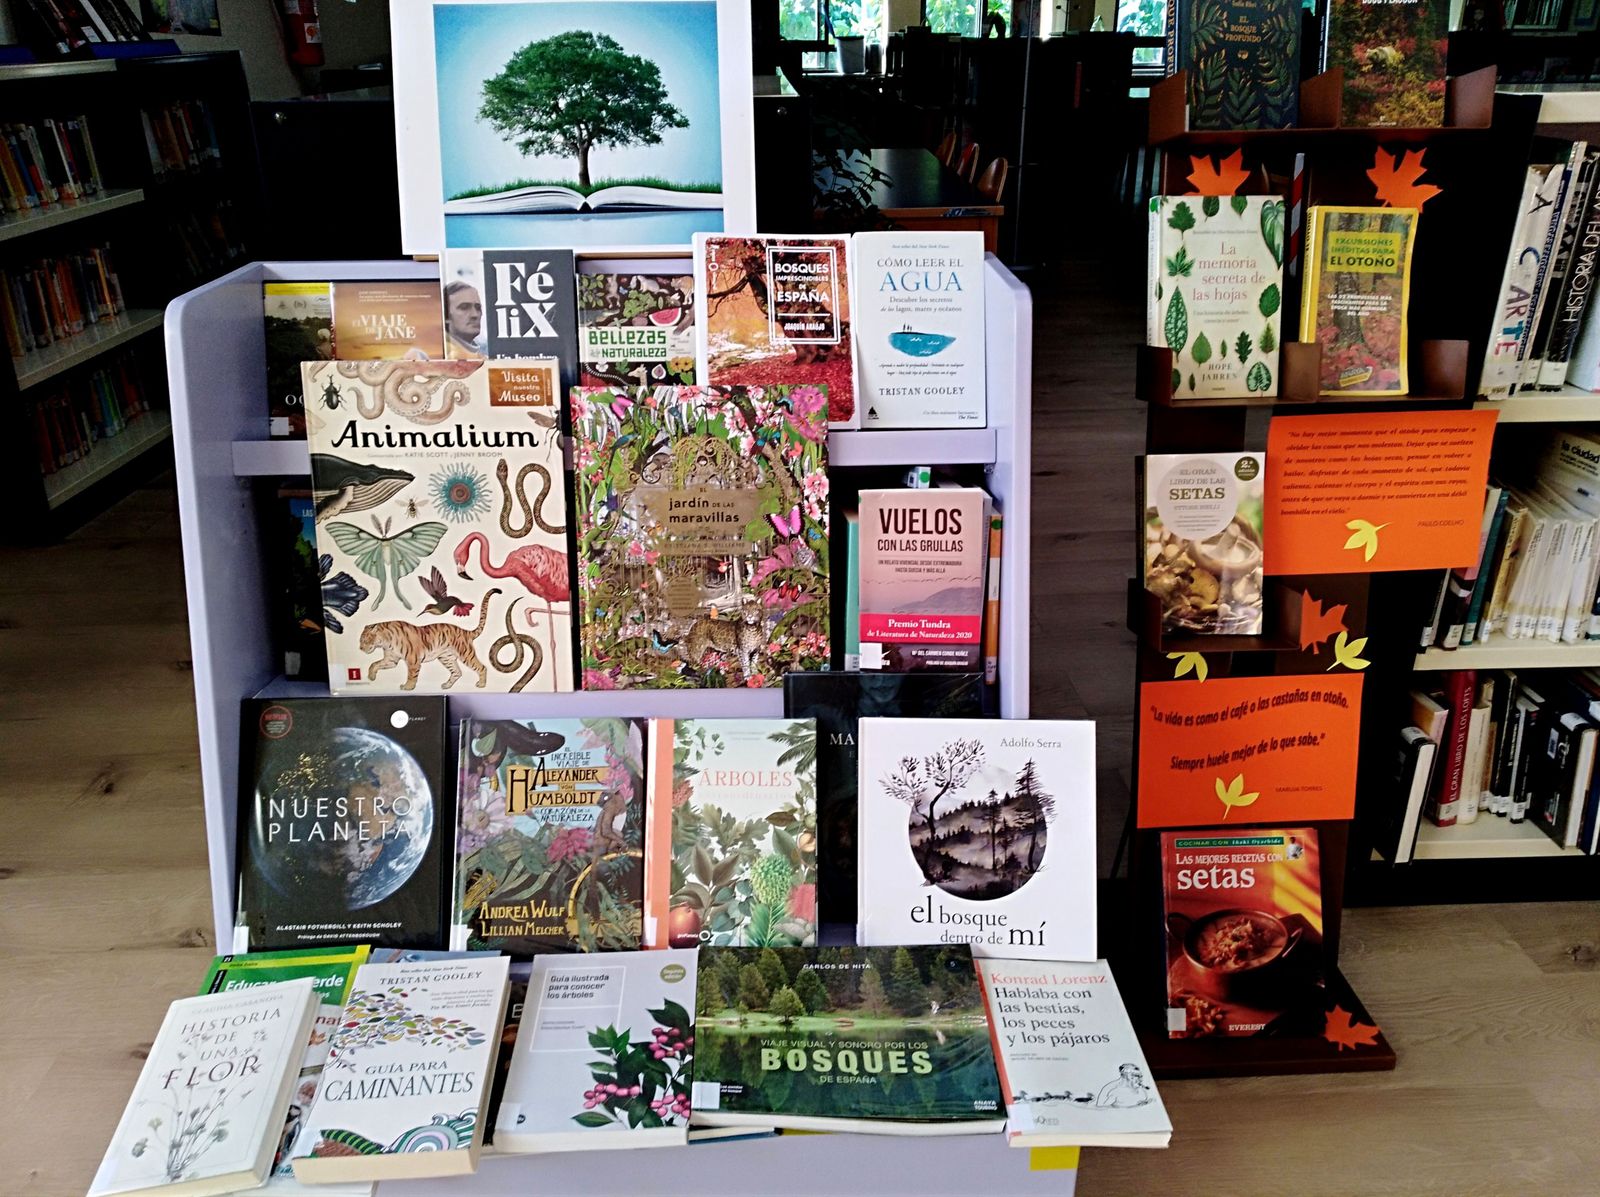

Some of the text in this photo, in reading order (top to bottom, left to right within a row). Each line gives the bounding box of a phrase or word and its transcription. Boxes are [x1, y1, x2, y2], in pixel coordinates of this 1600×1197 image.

[1220, 242, 1236, 255] La
[877, 256, 964, 267] CÓMO LEER EL
[1198, 258, 1257, 269] memoria
[1330, 255, 1395, 267] EL OTOÑO
[775, 263, 829, 273] BOSQUES
[492, 262, 554, 305] Fé
[880, 271, 962, 292] AGUA
[1201, 271, 1266, 284] secreta de
[1563, 250, 1596, 322] HISTORIA
[777, 289, 829, 302] ESPAÑA
[1193, 287, 1248, 304] las hojas
[360, 314, 407, 327] VIAJE
[375, 326, 416, 340] JANE
[1208, 363, 1233, 371] HOPE
[502, 371, 539, 382] Visita
[498, 391, 541, 402] Museo
[879, 386, 965, 396] TRISTAN GOOLEY
[331, 420, 539, 448] Animalium
[1572, 446, 1599, 463] ciudad
[1169, 488, 1225, 500] SETAS
[669, 497, 709, 511] jardín
[669, 512, 739, 523] maravillas
[879, 508, 962, 535] VUELOS
[878, 539, 963, 552] CON LAS GRULLAS
[888, 619, 951, 629] Premio Tundra
[876, 630, 908, 638] Literatura
[919, 631, 954, 639] Naturaleza
[1165, 712, 1182, 726] vida
[1184, 715, 1193, 726] es
[1196, 712, 1218, 725] como
[1221, 706, 1229, 720] el
[1230, 700, 1248, 719] café
[1257, 697, 1269, 711] las
[1271, 689, 1308, 707] castañas
[1311, 691, 1321, 701] en
[1323, 691, 1348, 708] otoño.
[1000, 738, 1062, 749] Adolfo Serra
[1170, 755, 1204, 773] Siempre
[1206, 750, 1229, 767] huele
[1231, 744, 1256, 761] mejor
[1257, 739, 1268, 754] de
[1270, 737, 1278, 751] lo
[1280, 736, 1295, 751] que
[530, 757, 604, 790] ALEXANDER
[698, 768, 792, 787] ÁRBOLES
[509, 769, 596, 812] HUMBOLDT
[269, 796, 412, 819] NUESTRO
[541, 814, 594, 822] NATURALEZA
[268, 820, 412, 843] PLANETA
[1195, 854, 1229, 866] MEJORES
[1231, 854, 1265, 863] RECETAS
[1267, 853, 1283, 862] CON
[1177, 865, 1256, 890] setas
[479, 900, 565, 922] ANDREA WULF
[910, 895, 1008, 931] el bosque
[481, 921, 565, 937] LILLIAN MELCHER
[940, 921, 1046, 947] dentro de mí
[379, 972, 483, 985] TRISTAN GOOLEY
[571, 974, 610, 982] ilustrada
[991, 974, 1107, 985] Konrad Lorenz
[995, 987, 1092, 999] Hablaba con
[999, 1002, 1085, 1014] las bestias,
[181, 1008, 281, 1034] HISTORIA
[1002, 1017, 1075, 1031] los peces
[1228, 1023, 1266, 1032] EVEREST
[215, 1031, 238, 1044] DE
[760, 1039, 788, 1047] VIAJE
[790, 1040, 825, 1048] VISUAL
[885, 1041, 906, 1049] POR
[1007, 1031, 1111, 1048] y los pájaros
[200, 1046, 238, 1061] UNA
[365, 1060, 448, 1075] GUÍA PARA
[760, 1048, 933, 1076] BOSQUES
[163, 1055, 259, 1089] FLOR
[837, 1075, 877, 1084] ESPAÑA
[325, 1072, 475, 1102] CAMINANTES
